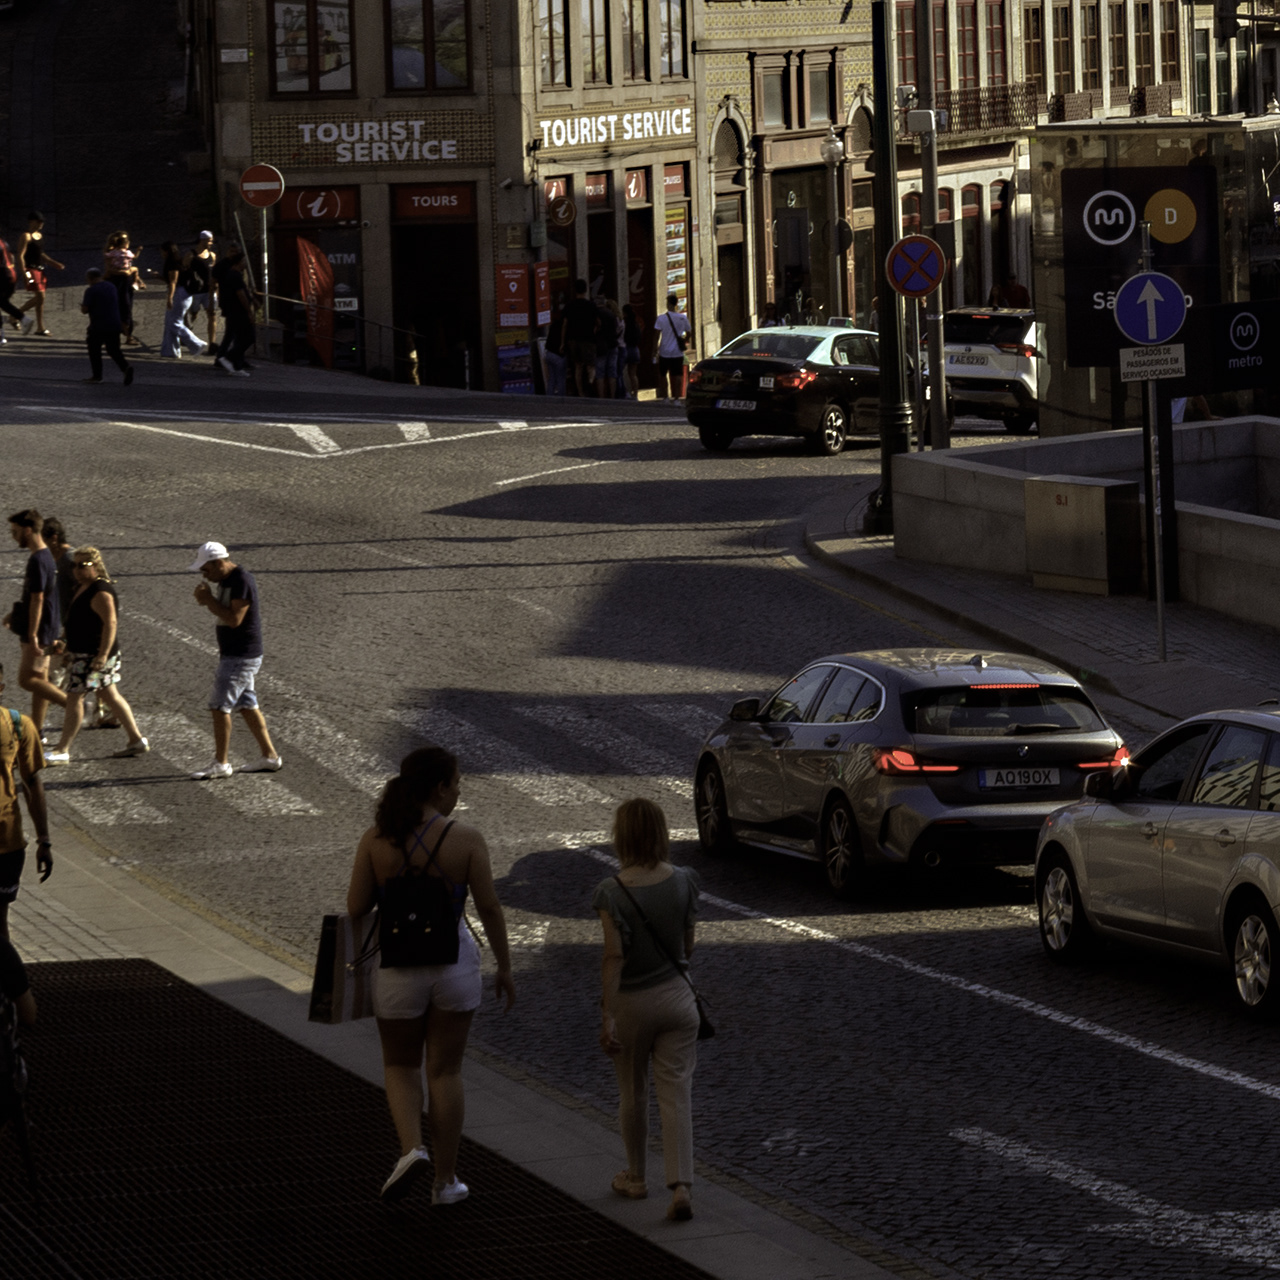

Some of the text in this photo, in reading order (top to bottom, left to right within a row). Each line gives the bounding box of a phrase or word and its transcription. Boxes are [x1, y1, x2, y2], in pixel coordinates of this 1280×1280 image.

[298, 120, 426, 143] TOURIST
[540, 107, 692, 148] TOURIST SERVICE
[336, 140, 458, 163] SERVICE
[586, 184, 605, 196] TOURS
[412, 195, 458, 208] TOURS
[1165, 207, 1177, 225] D
[1092, 291, 1116, 310] Sã
[1163, 347, 1171, 355] DE
[1126, 356, 1179, 368] PASSAGEIROS EM
[1228, 354, 1263, 369] metro
[1150, 367, 1184, 377] OCASIONAL
